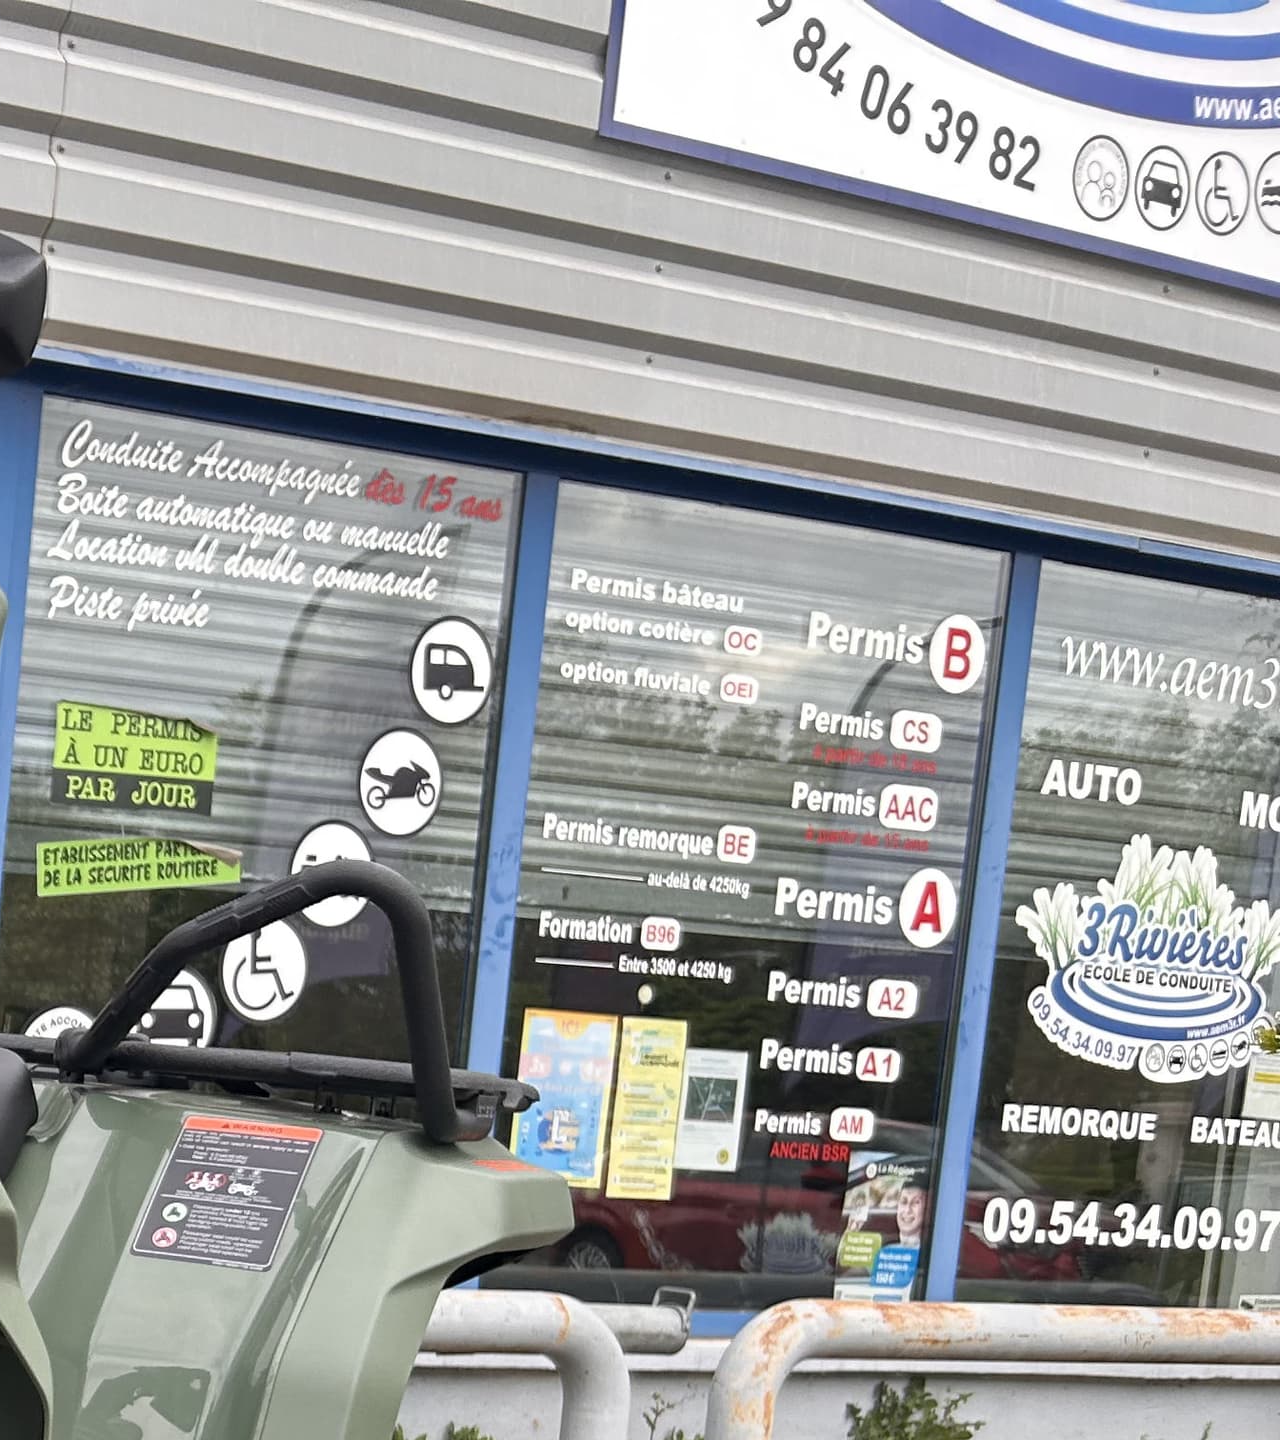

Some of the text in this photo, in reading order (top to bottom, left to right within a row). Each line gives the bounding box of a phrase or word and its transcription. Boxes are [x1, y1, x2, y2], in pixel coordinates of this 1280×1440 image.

[793, 17, 851, 97] 84
[860, 65, 913, 135] 06
[925, 99, 978, 164] 39
[989, 127, 1041, 192] 82
[61, 419, 503, 522] Conduite Accompagnée dès 15 ans
[56, 472, 449, 560] Boite automatique ou manuelle
[47, 519, 440, 601] Location vhl double commande
[48, 575, 209, 632] Piste privée
[572, 568, 744, 615] Permis bâteau
[565, 612, 757, 651] option cotière OC
[807, 611, 972, 680] Permis B
[561, 661, 628, 686] option
[634, 666, 710, 696] fluviale
[61, 707, 204, 742] LE PERMIS
[800, 703, 928, 743] Permis CS
[62, 736, 204, 775] À UN EURO
[65, 775, 196, 809] PAR JOUR
[1040, 759, 1142, 806] AUTO
[792, 782, 933, 823] Permis AAC
[44, 841, 149, 865] ETABLISSEMENT
[543, 813, 749, 859] Permis remorque BE
[44, 859, 218, 888] DE LA SECURITE ROUTIERE
[647, 870, 689, 890] au-delà
[692, 875, 706, 891] de
[775, 878, 942, 933] Permis A
[539, 911, 675, 943] Formation B96
[618, 955, 647, 974] Entre
[650, 958, 675, 976] 3500
[691, 961, 716, 979] 4250
[718, 964, 732, 982] kg
[1084, 964, 1232, 993] ECOLE DE CONDUITE
[768, 971, 905, 1011] Permis A2
[760, 1038, 894, 1077] Permis A1
[754, 1109, 821, 1135] Permis
[837, 1117, 863, 1133] AM
[1001, 1103, 1158, 1141] REMORQUE
[770, 1142, 849, 1162] ANCIEN BSR
[982, 1197, 1280, 1252] 09.54.34.09.97
